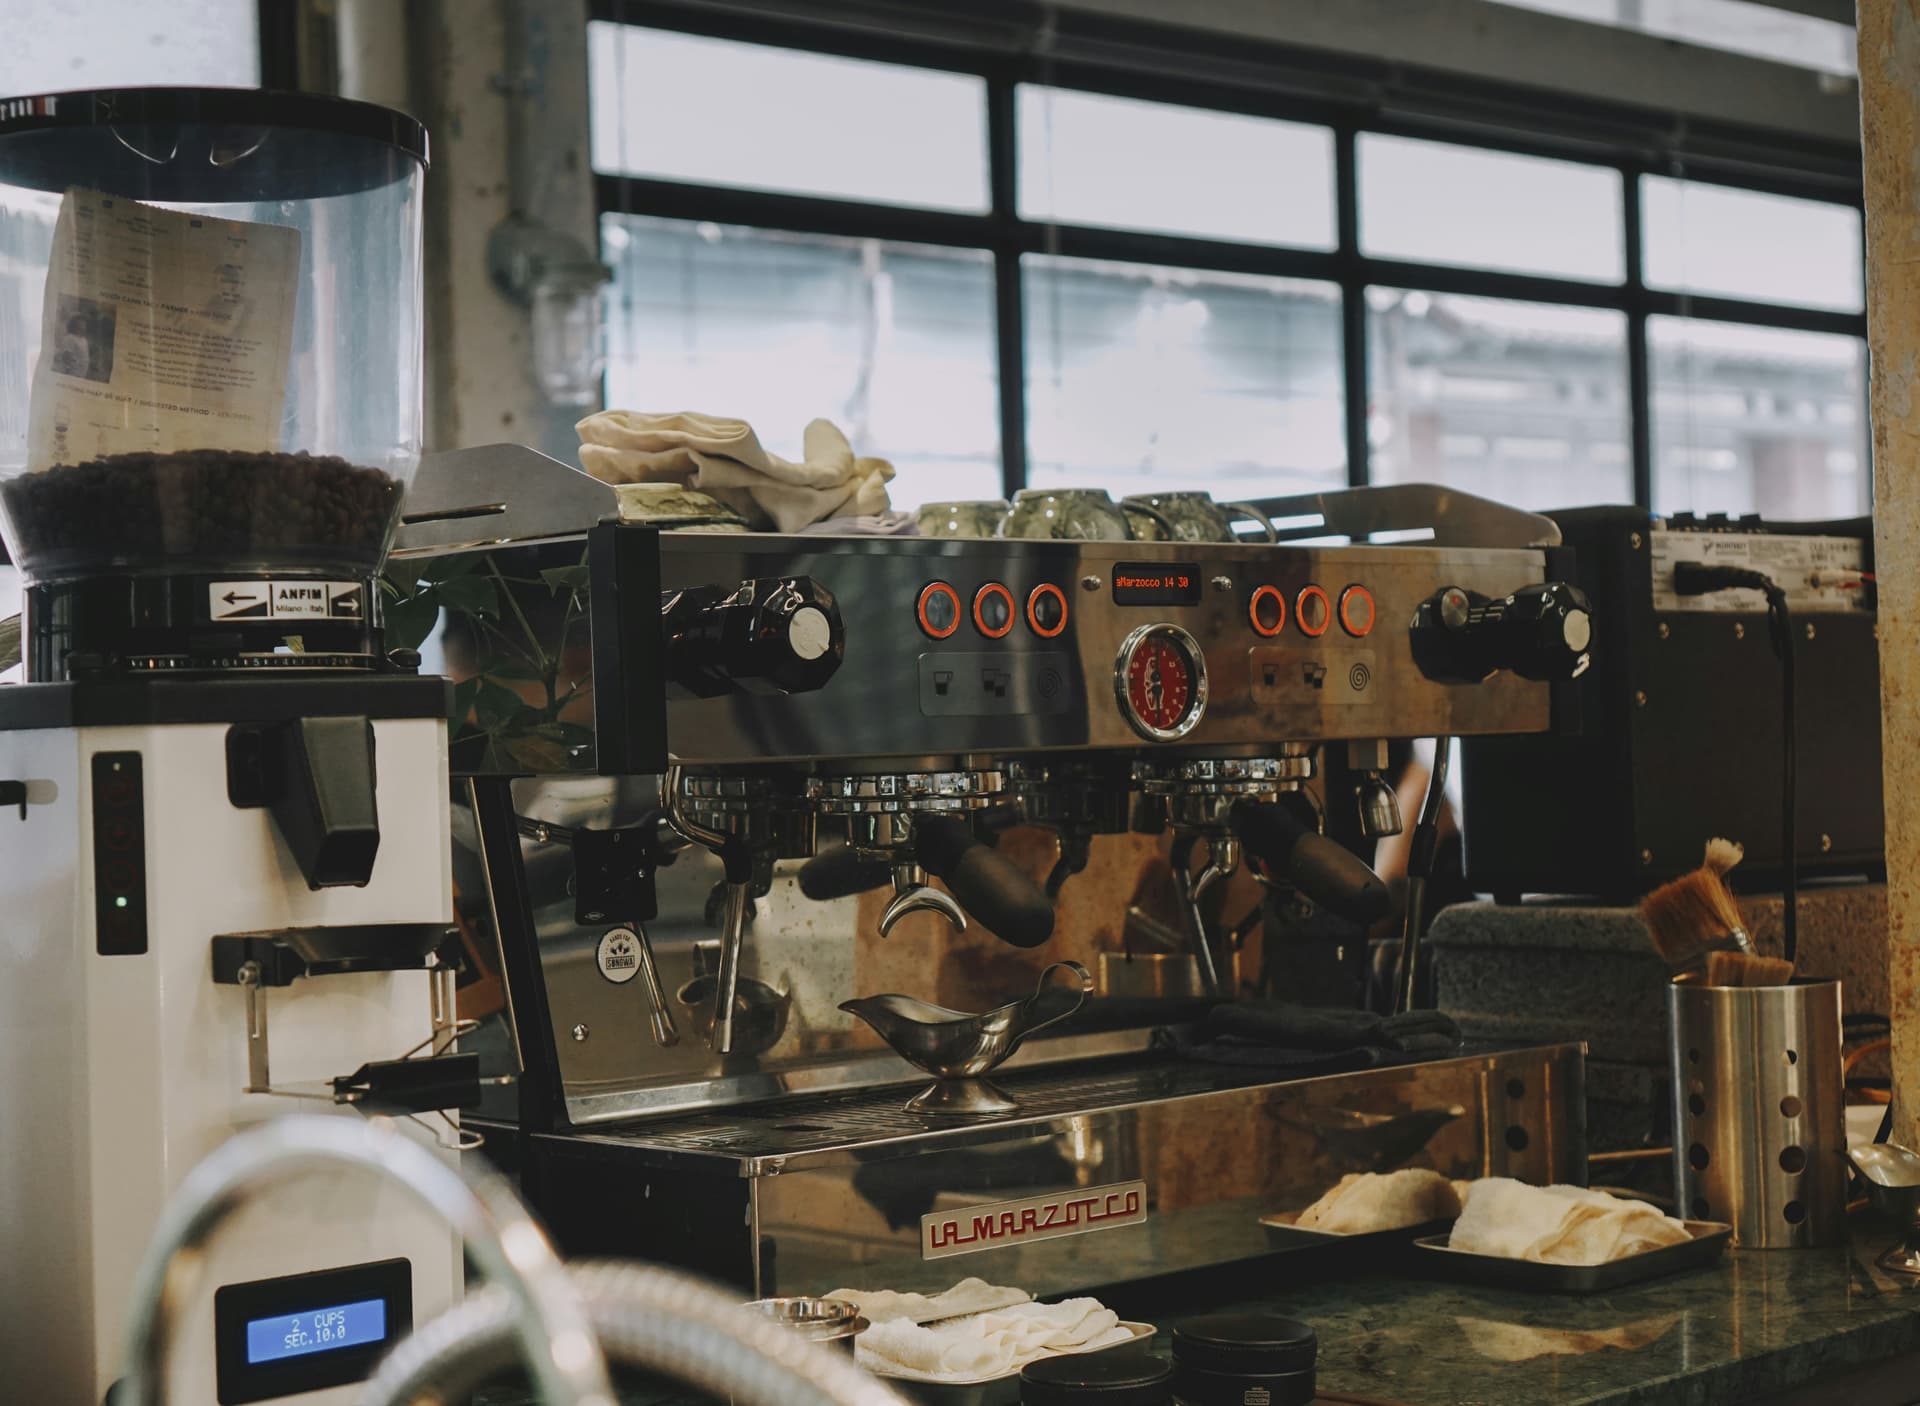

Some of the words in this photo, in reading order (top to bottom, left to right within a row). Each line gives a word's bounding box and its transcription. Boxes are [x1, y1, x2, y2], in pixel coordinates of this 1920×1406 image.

[279, 588, 322, 600] ANFIM
[930, 1220, 958, 1250] LA
[973, 1190, 1140, 1241] MARZOCCO
[291, 1319, 301, 1333] 2
[314, 1311, 345, 1329] CUPS
